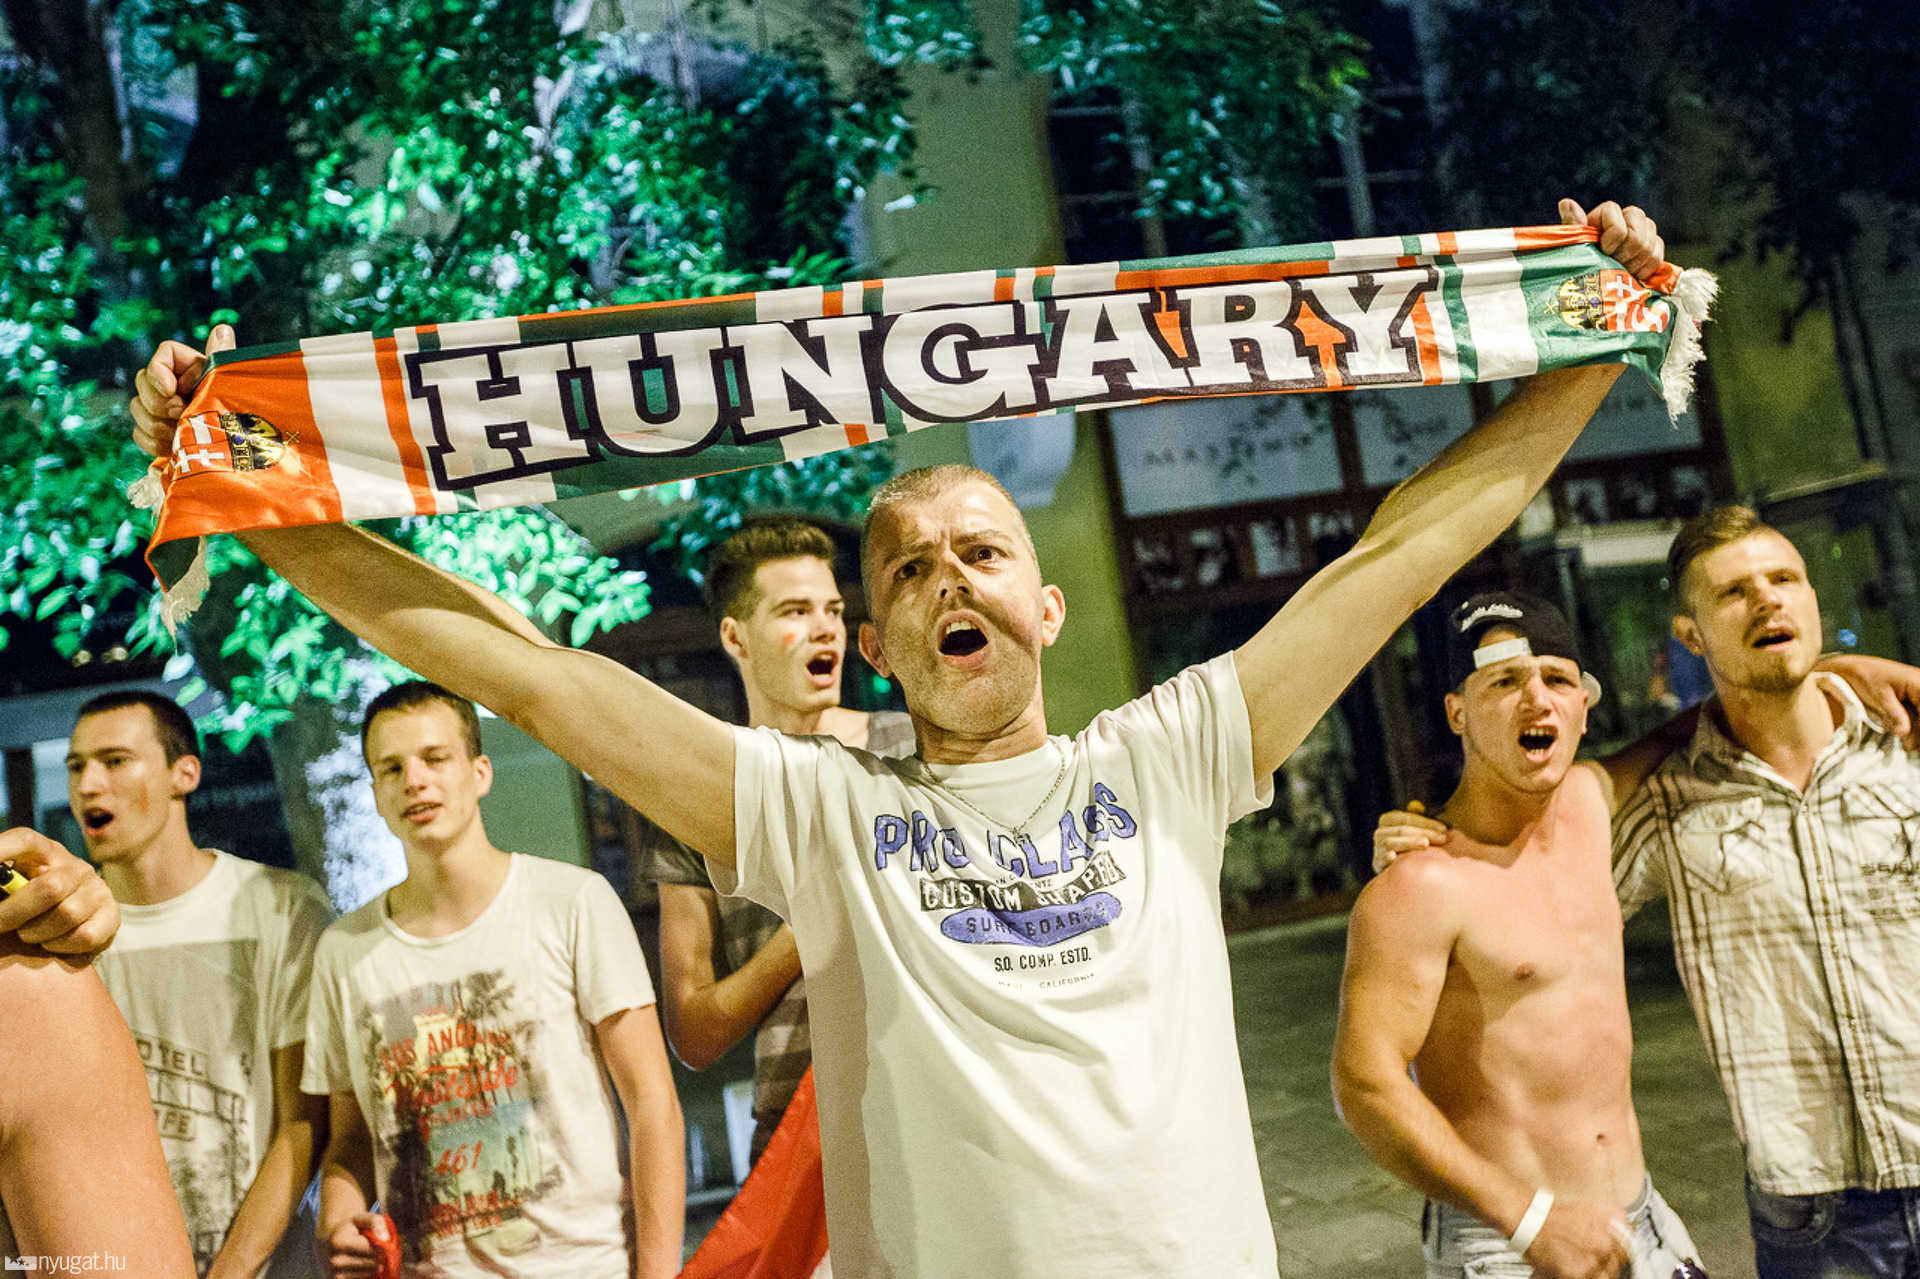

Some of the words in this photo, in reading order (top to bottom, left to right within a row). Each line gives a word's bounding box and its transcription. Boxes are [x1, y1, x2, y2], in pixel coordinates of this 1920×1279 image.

[406, 266, 1439, 490] HUNGARY
[874, 810, 971, 872] PRO
[922, 879, 1023, 912] CUSTOM
[1060, 946, 1092, 966] ESTD.
